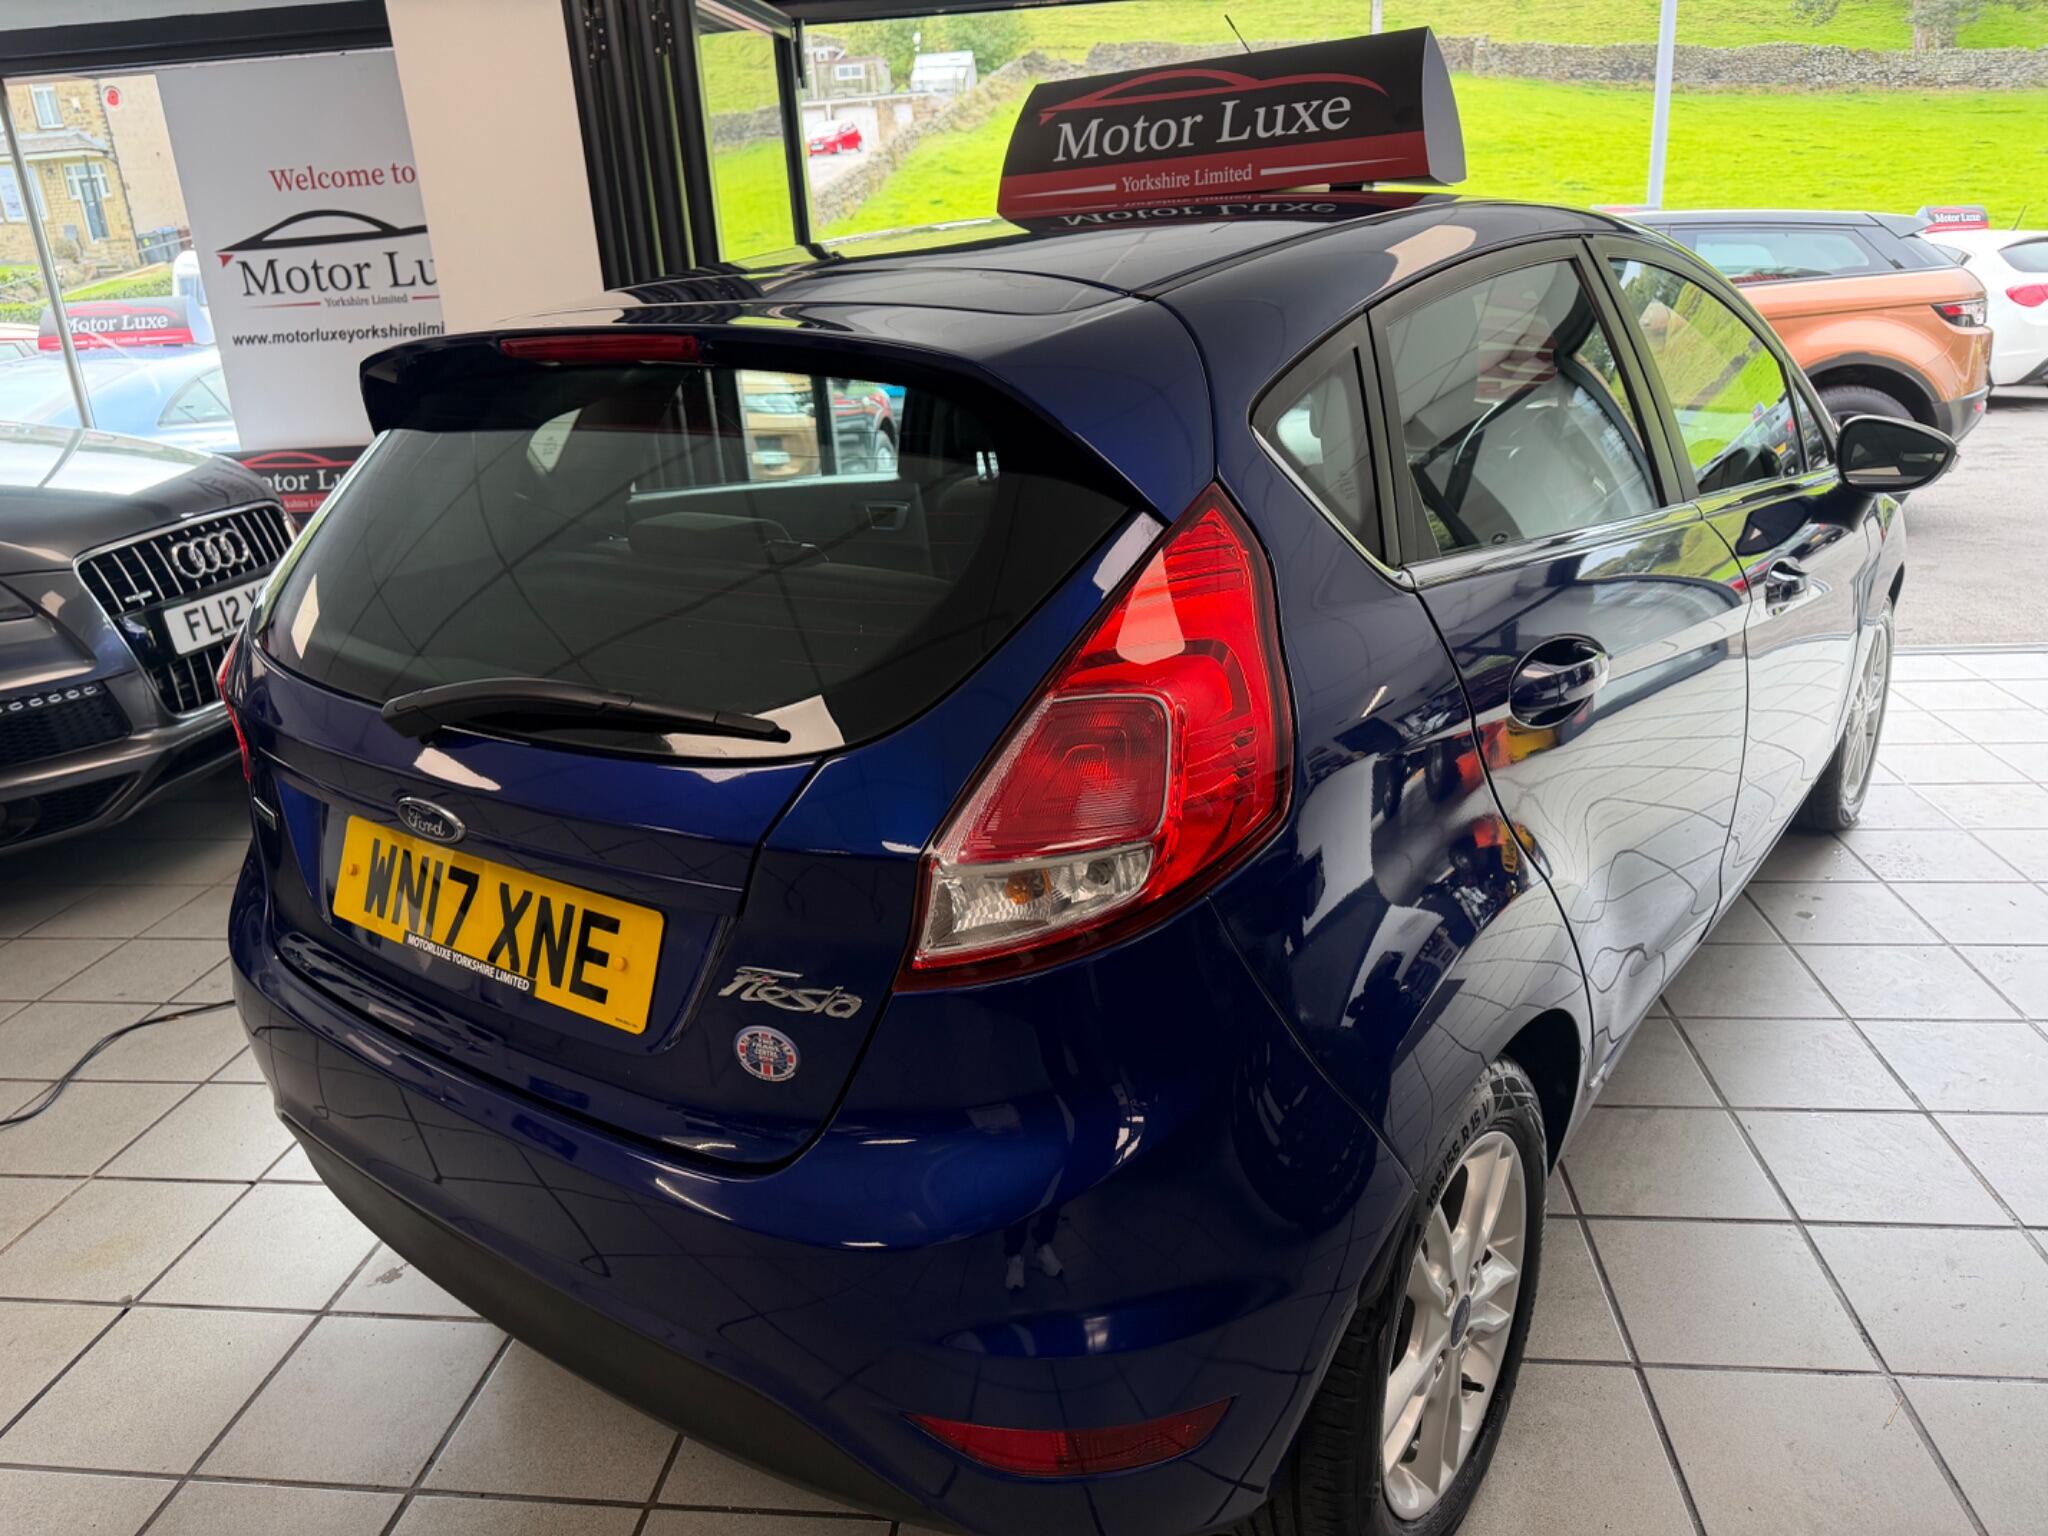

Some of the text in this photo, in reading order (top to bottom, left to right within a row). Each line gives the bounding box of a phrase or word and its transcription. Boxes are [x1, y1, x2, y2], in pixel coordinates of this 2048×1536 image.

[1053, 95, 1352, 163] Motor Luxe
[268, 160, 416, 192] Welcome to
[1121, 164, 1253, 194] Yorkshire Limited
[236, 256, 371, 297] Motor
[324, 294, 408, 308] Yorkshire Limited
[121, 314, 169, 331] Luxe
[408, 806, 446, 837] Ford
[363, 838, 621, 1005] WN17 XNE
[407, 933, 530, 992] MOTORLUXE YORKSHIRE LIMITED
[718, 966, 863, 1019] Fiesta
